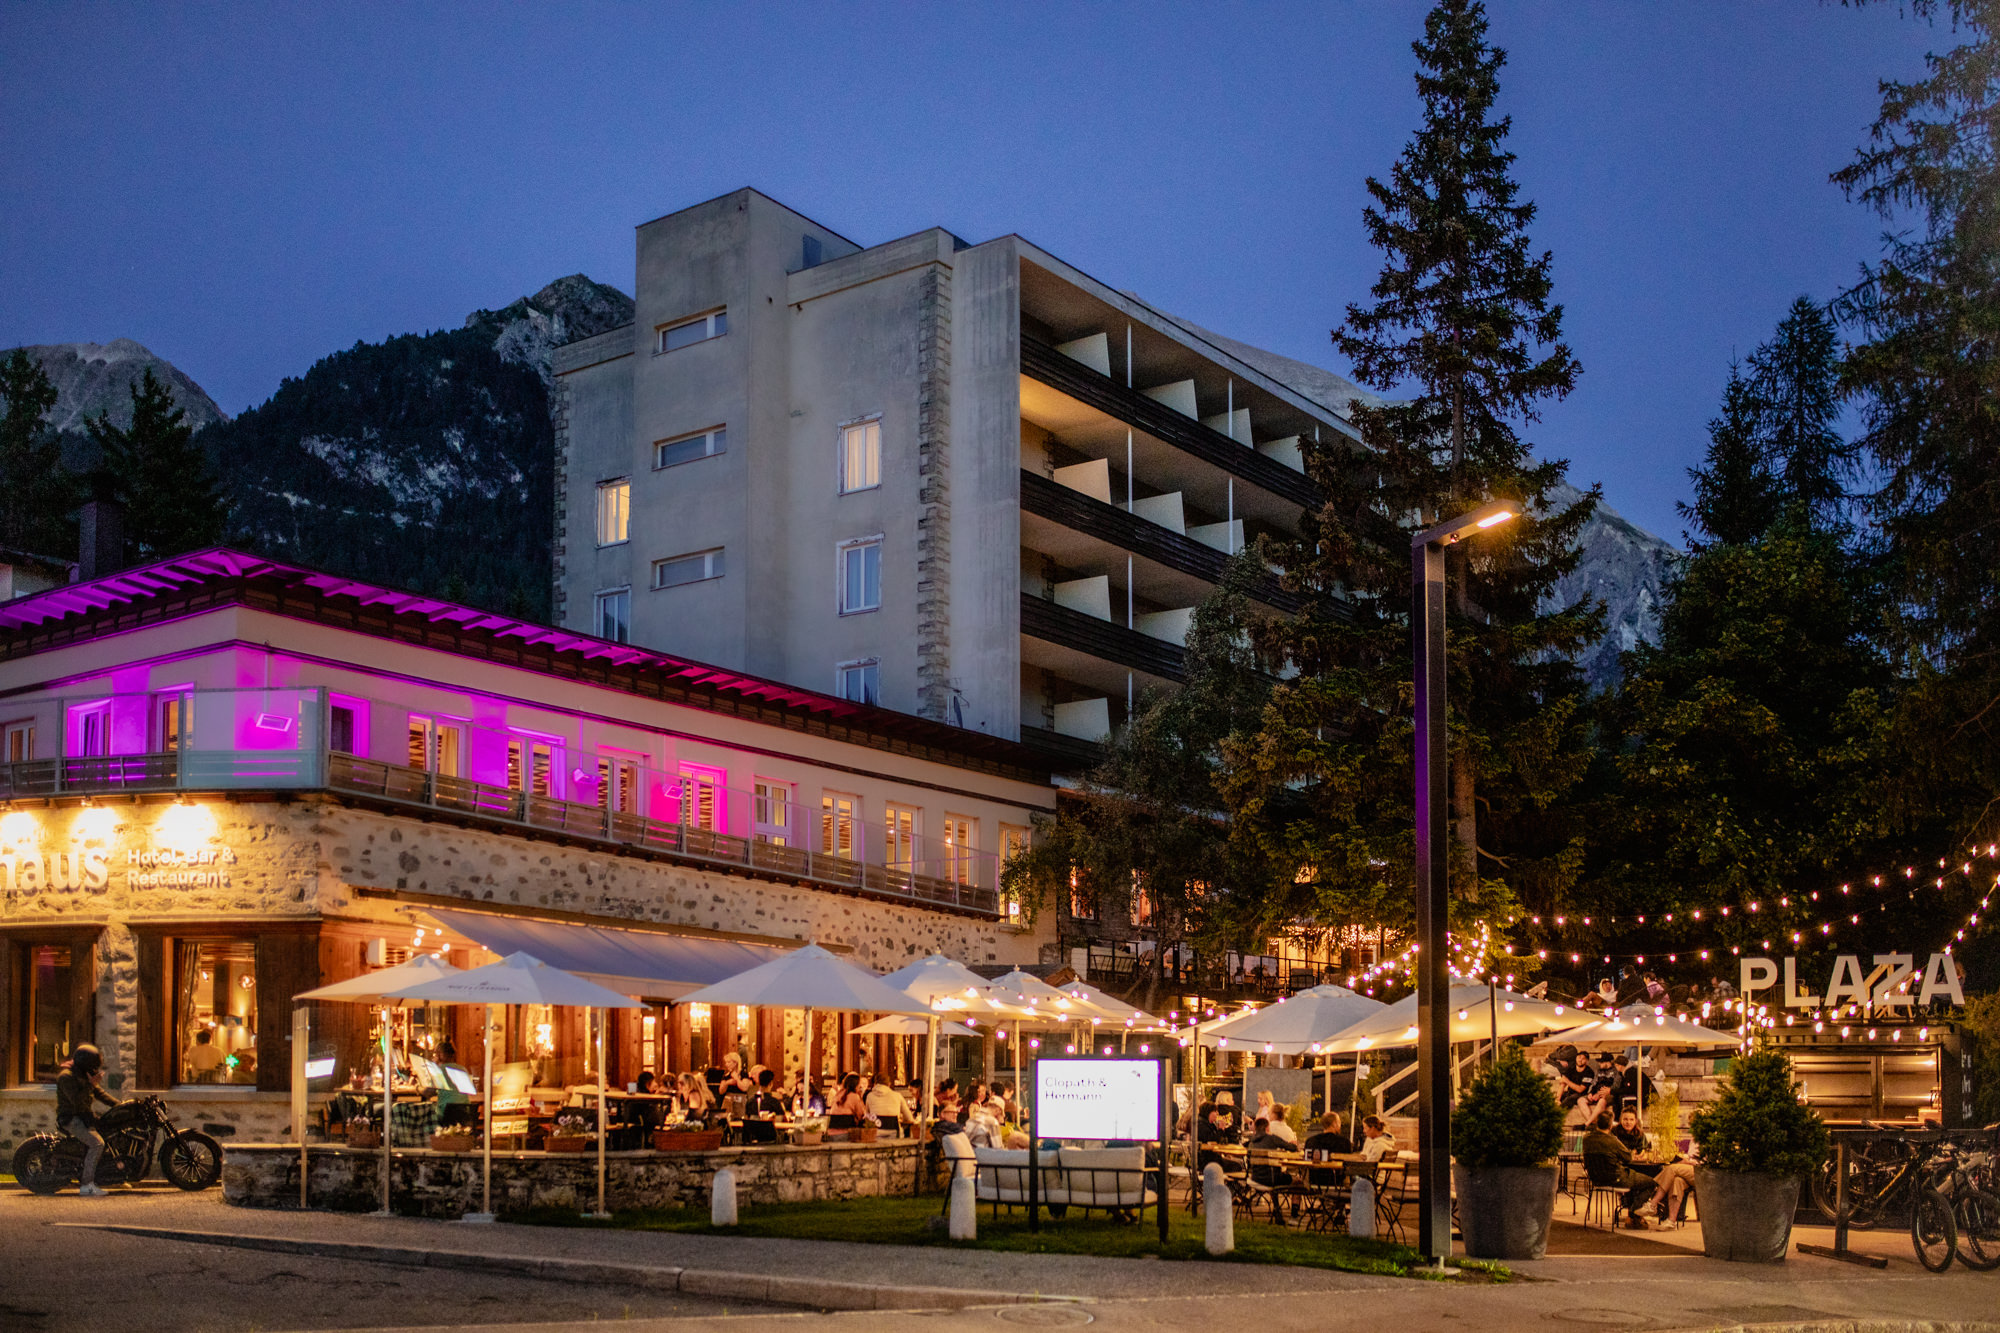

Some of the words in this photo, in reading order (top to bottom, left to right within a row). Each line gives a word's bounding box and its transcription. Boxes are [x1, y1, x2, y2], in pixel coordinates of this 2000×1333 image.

[186, 848, 218, 863] Bar
[221, 847, 235, 861] &
[127, 870, 229, 886] Restaurant
[1740, 953, 1965, 1007] PLAZA
